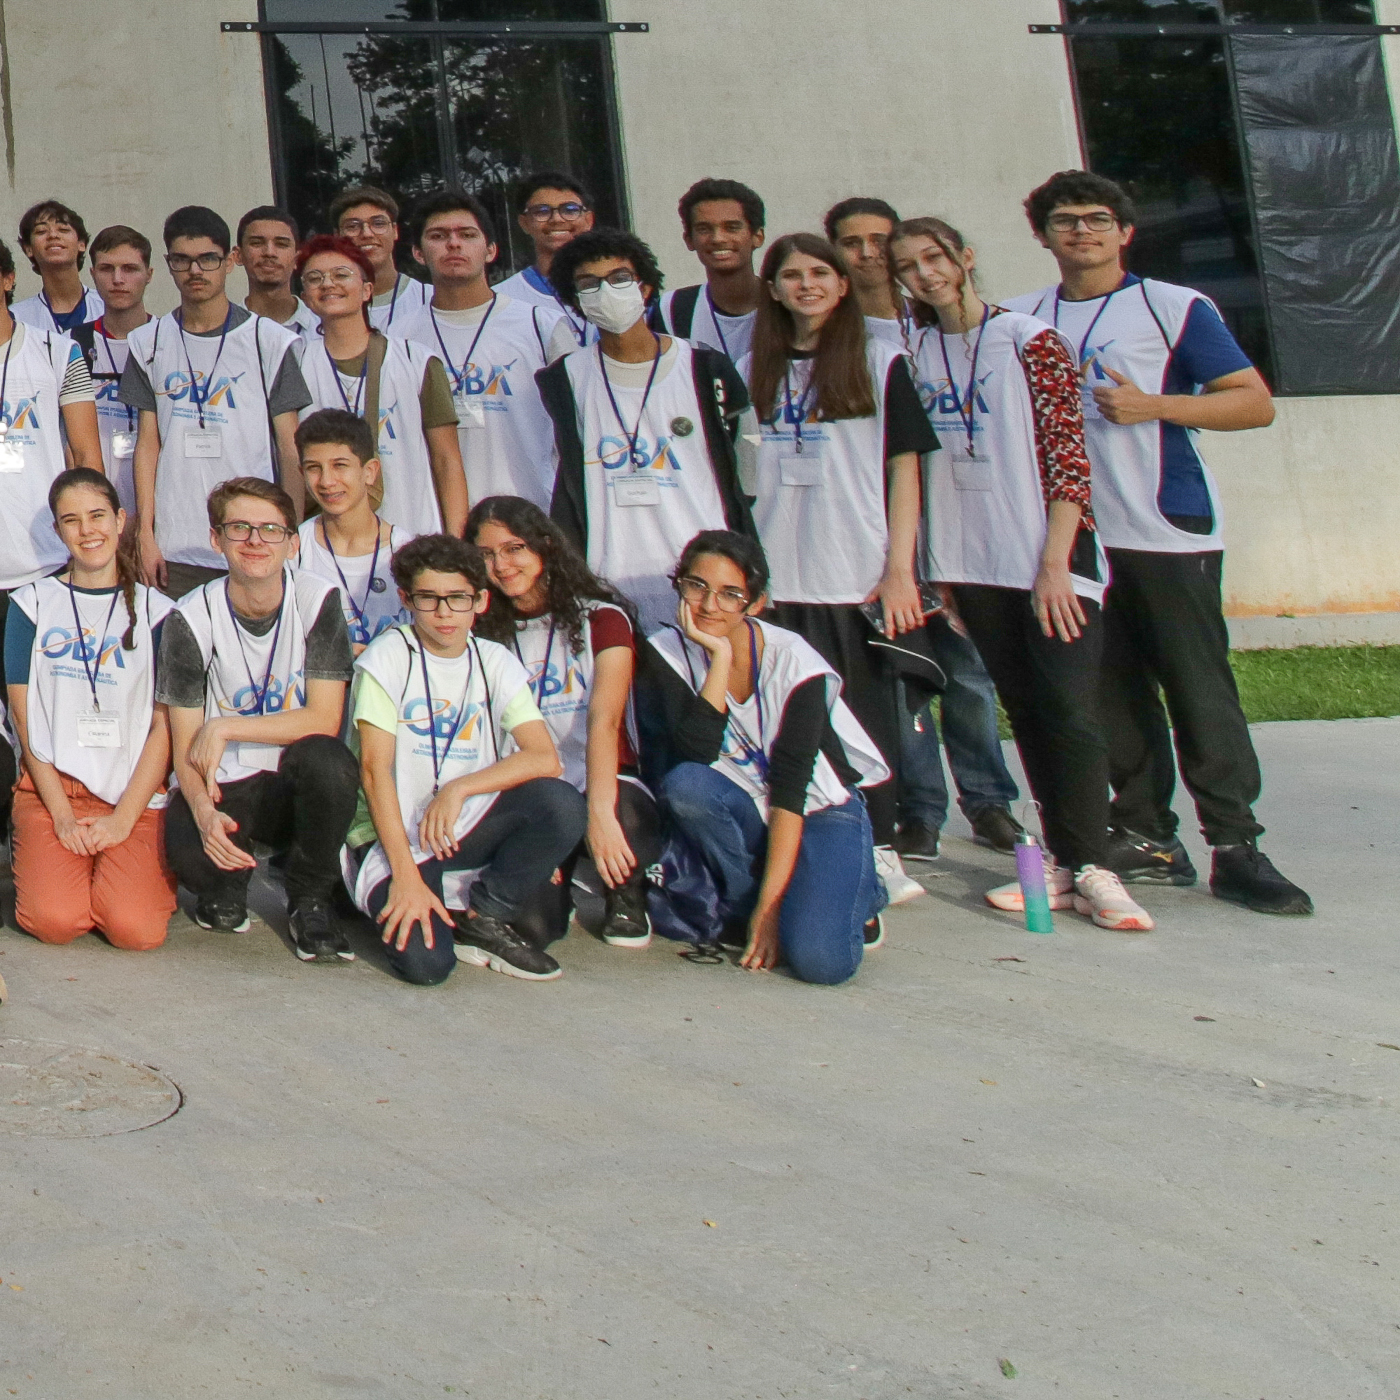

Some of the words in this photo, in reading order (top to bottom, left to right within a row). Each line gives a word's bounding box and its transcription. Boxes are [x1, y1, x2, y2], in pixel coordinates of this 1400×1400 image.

[164, 372, 236, 409] OBA
[597, 435, 682, 470] OBA
[41, 626, 126, 669] OBA
[233, 671, 306, 715] OBA
[403, 696, 483, 742] OBA
